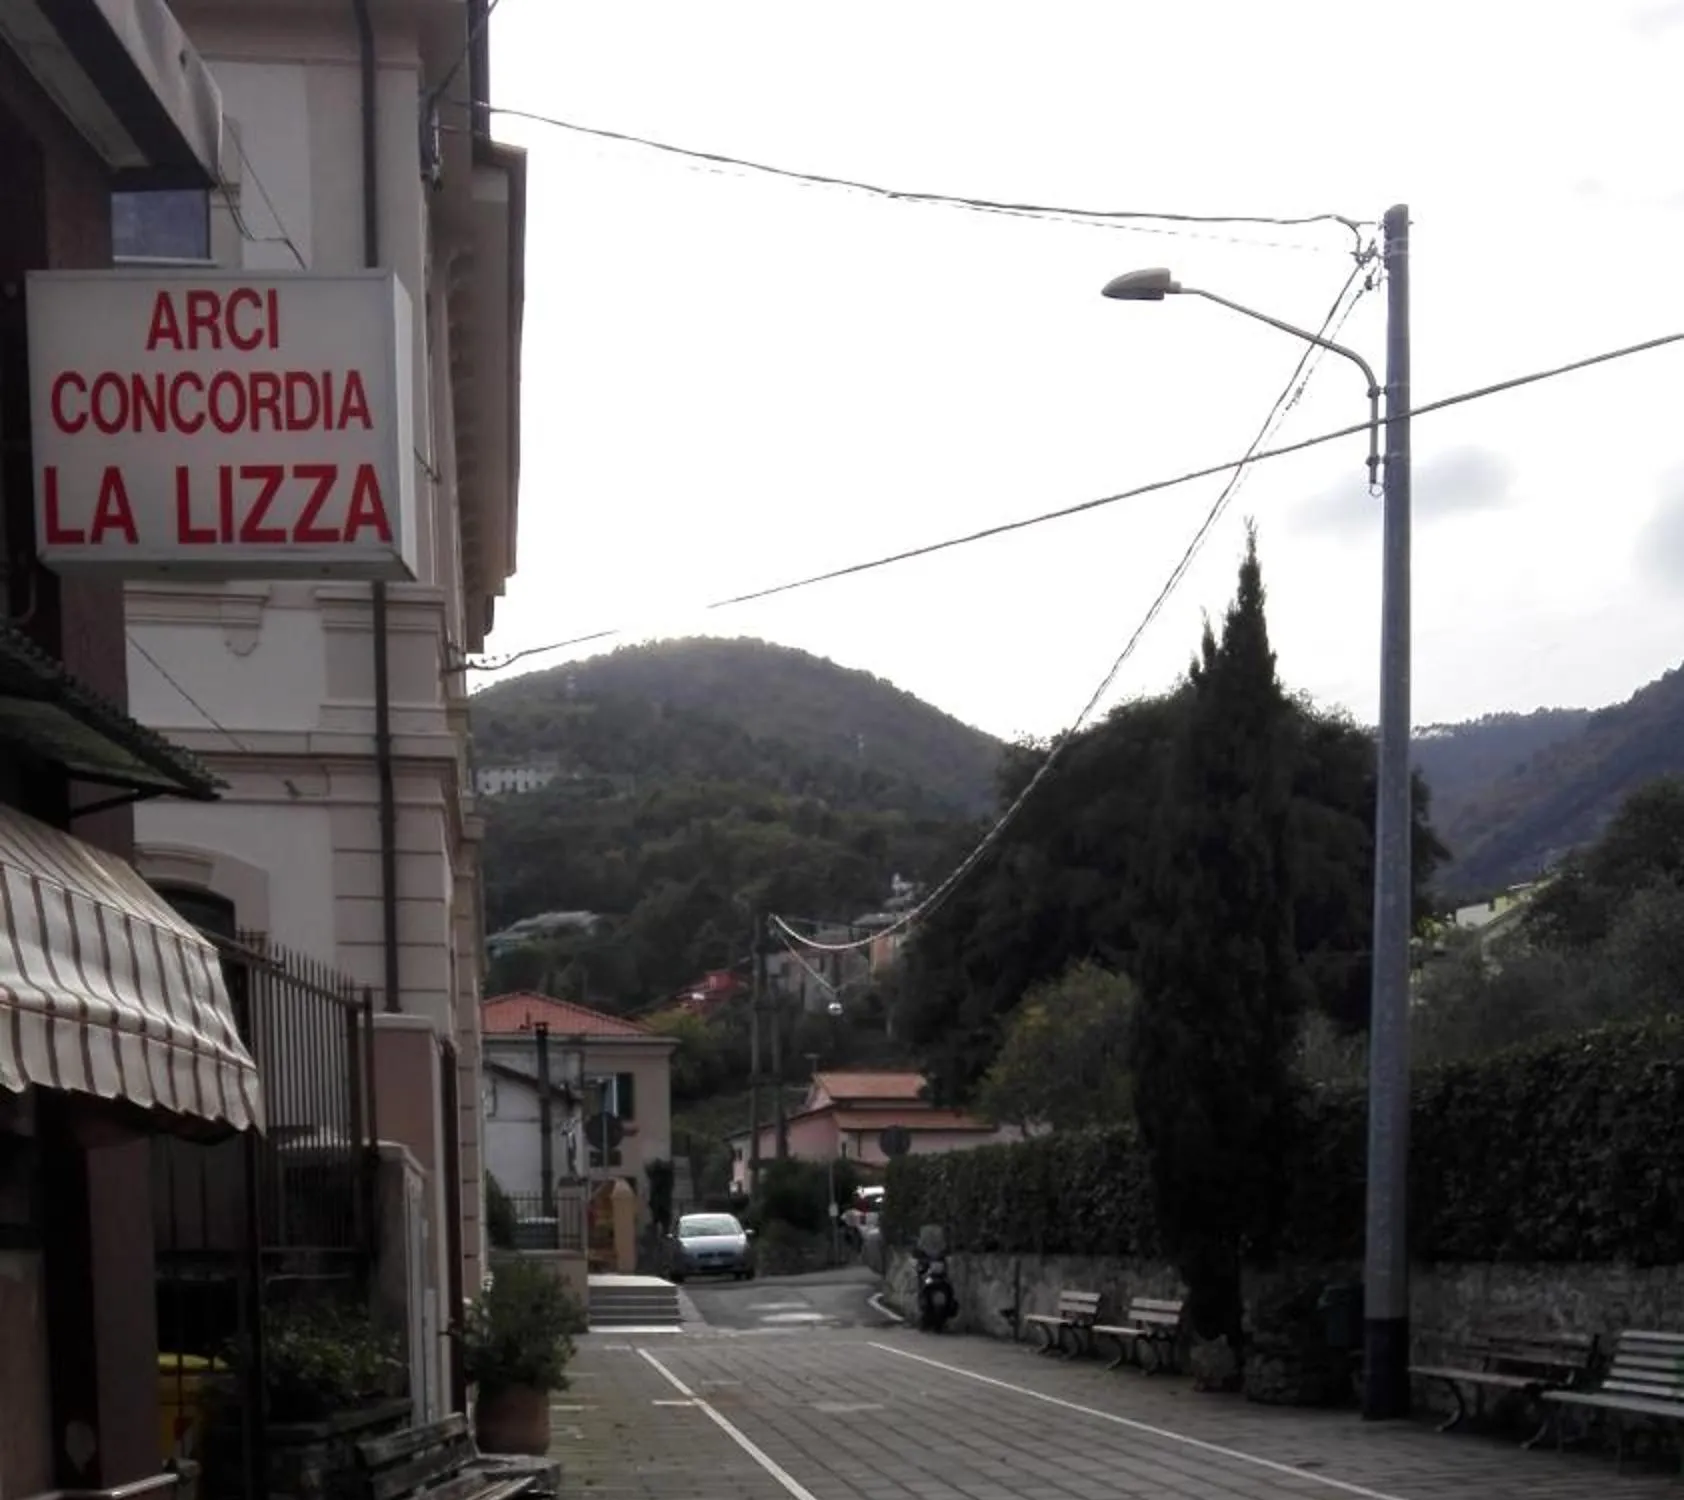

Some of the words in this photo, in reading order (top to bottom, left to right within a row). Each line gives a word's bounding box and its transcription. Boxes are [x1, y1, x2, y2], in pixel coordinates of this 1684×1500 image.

[146, 287, 279, 351] ARCI
[51, 370, 373, 435] CONCORDIA
[43, 465, 139, 545] LA
[175, 463, 393, 545] LIZZA
